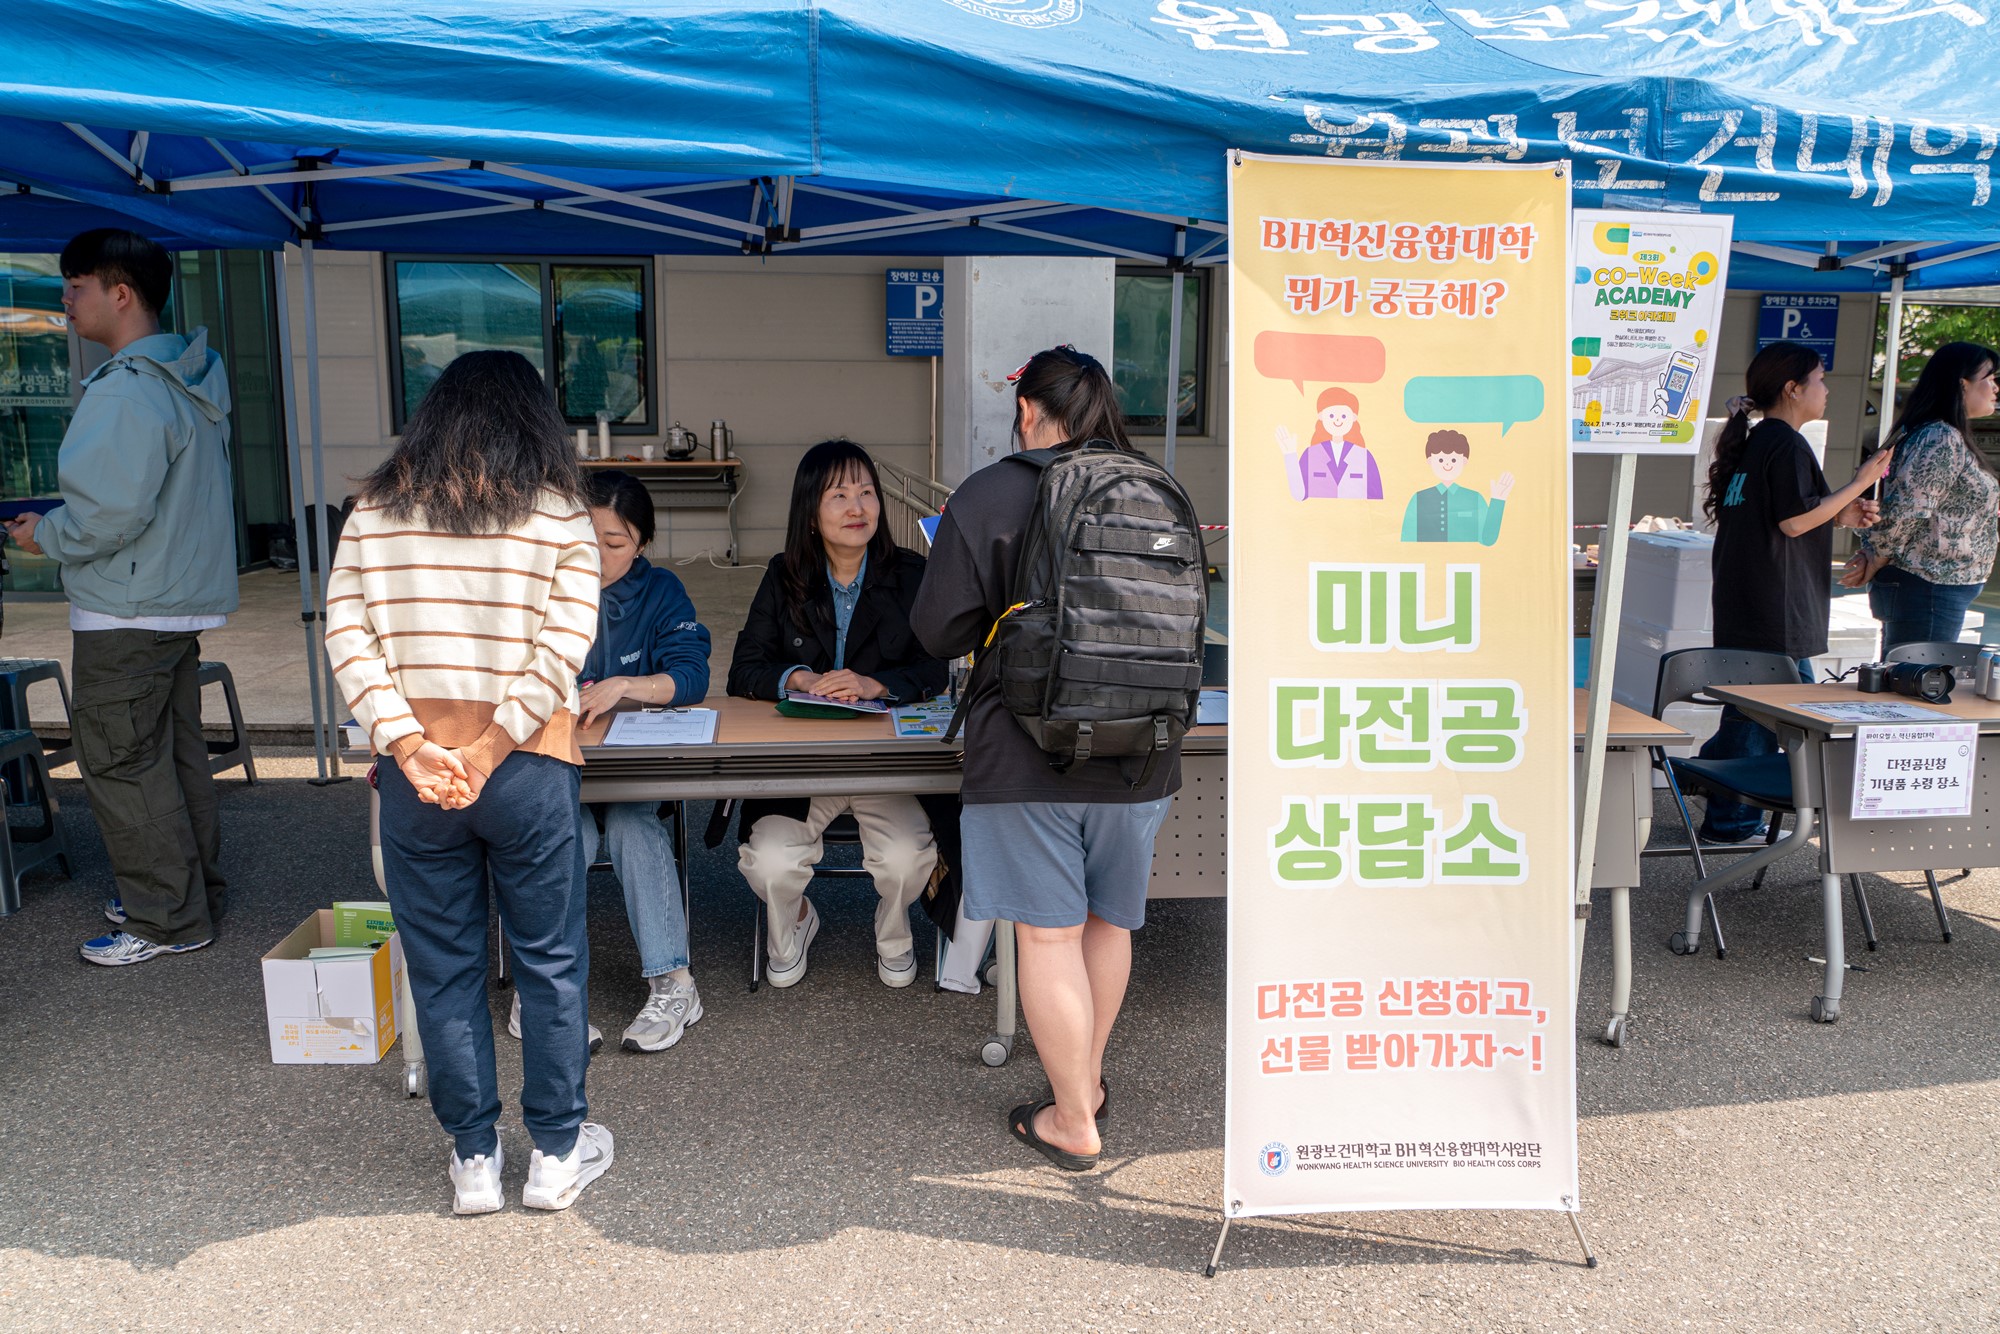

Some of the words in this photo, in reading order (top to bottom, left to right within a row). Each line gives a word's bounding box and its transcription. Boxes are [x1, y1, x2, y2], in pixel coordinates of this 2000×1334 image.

[1262, 219, 1535, 260] BH혁신융합대학
[890, 271, 919, 282] 장애인
[922, 272, 941, 283] 전용
[1593, 267, 1699, 290] CO-Week
[915, 285, 938, 319] P
[1287, 277, 1359, 314] 뭐가
[1369, 281, 1506, 315] 궁금해?
[1594, 287, 1696, 309] ACADEMY
[1781, 308, 1802, 339] P
[1316, 569, 1473, 645] 미니
[1276, 685, 1521, 764] 다전공
[1887, 757, 1947, 771] 다전공신청
[1870, 778, 1906, 791] 기념품
[1910, 777, 1934, 790] 수령
[1936, 776, 1960, 789] 장소
[1275, 802, 1521, 881] 상담소
[1257, 981, 1364, 1019] 다전공
[1378, 979, 1546, 1024] 신청하고,
[1260, 1035, 1332, 1074] 선물
[1345, 1033, 1542, 1072] 받아가자~!
[1296, 1143, 1392, 1160] 원광보건대학교
[1296, 1162, 1341, 1171] WONKWANG
[1343, 1161, 1372, 1169] HEALTH
[1374, 1160, 1404, 1169] SCIENCE
[1406, 1160, 1449, 1168] UNIVERSITY
[1453, 1160, 1466, 1168] BIO
[1467, 1160, 1496, 1168] HEALTH
[1497, 1160, 1516, 1168] COSS
[1517, 1160, 1542, 1169] CORPS
